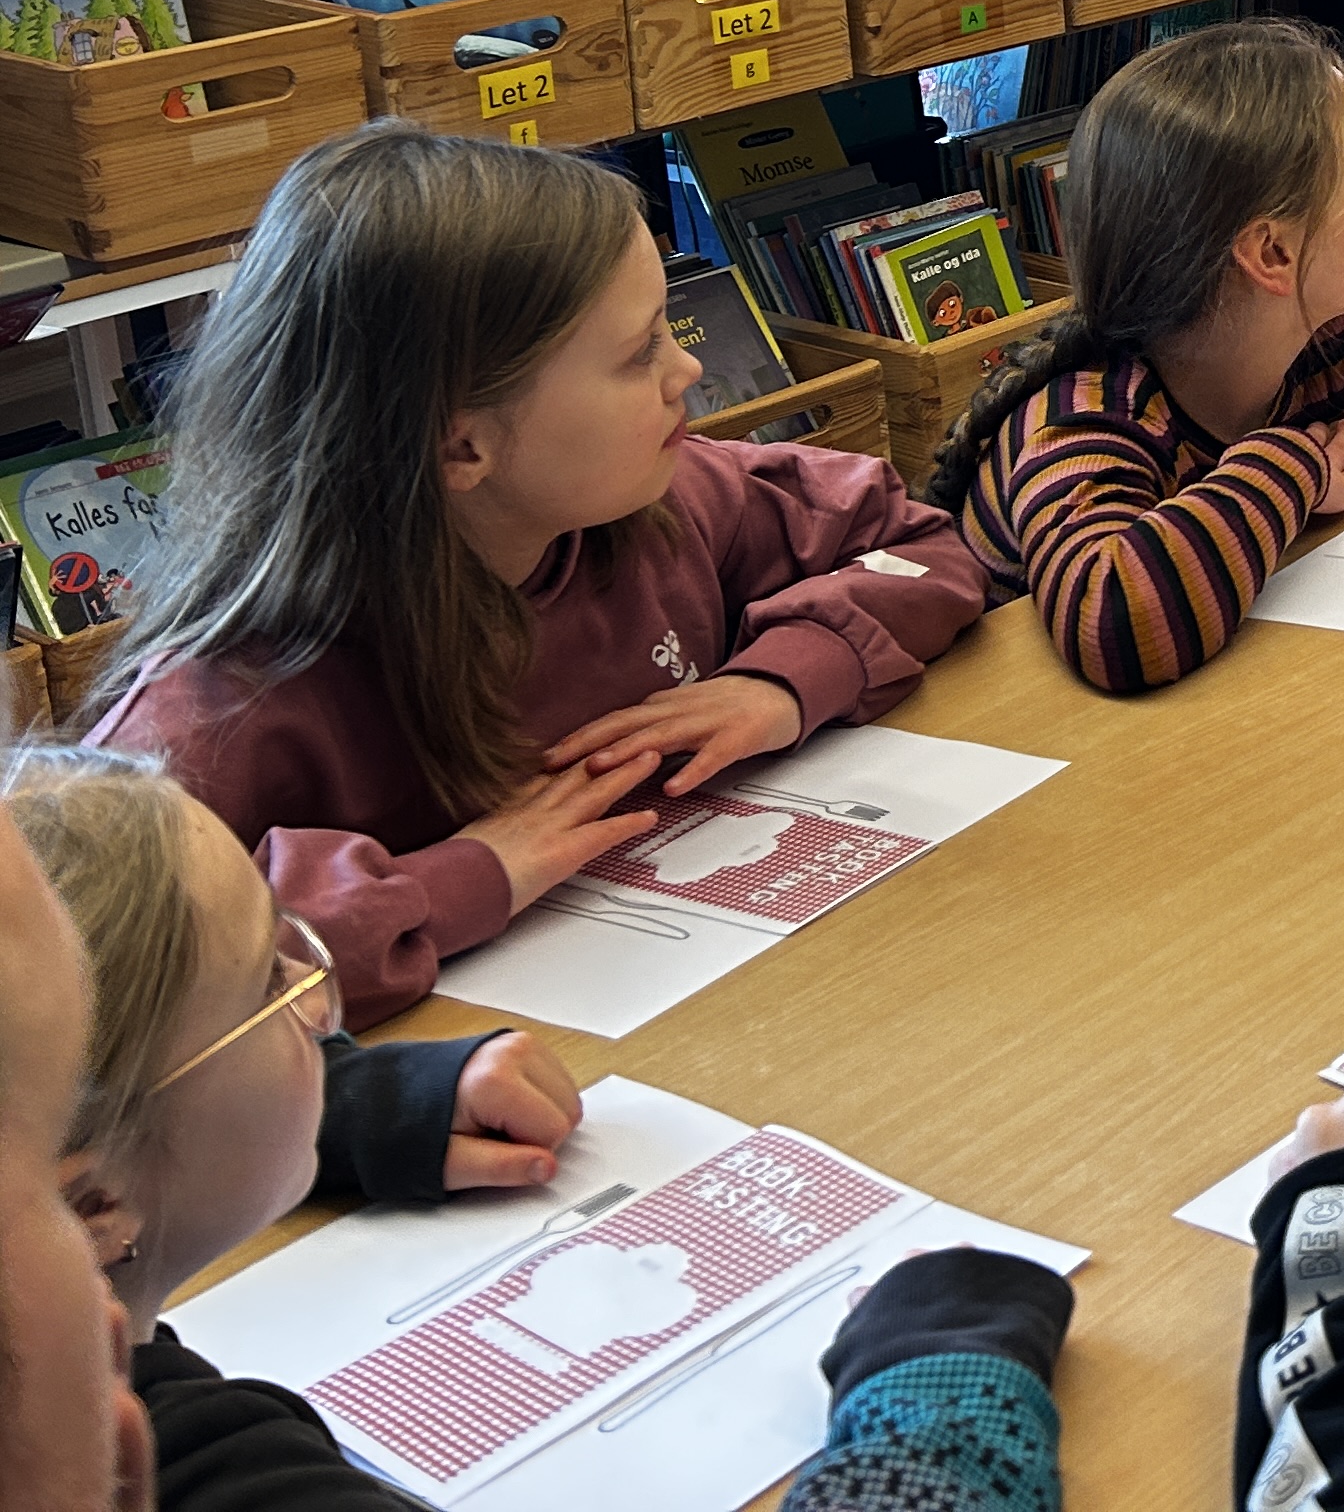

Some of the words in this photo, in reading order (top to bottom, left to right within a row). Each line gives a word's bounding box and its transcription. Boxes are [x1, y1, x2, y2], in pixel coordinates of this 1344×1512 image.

[718, 13, 753, 38] Let
[760, 8, 773, 30] 2
[968, 11, 979, 25] A
[745, 61, 755, 78] g
[487, 82, 527, 109] Let
[535, 74, 549, 98] 2
[520, 128, 528, 144] f
[739, 154, 815, 187] Momse
[911, 264, 942, 284] Kalle
[943, 257, 960, 272] og
[960, 247, 981, 264] Ida
[45, 500, 119, 542] Kalles
[749, 834, 876, 903] TASTING
[816, 838, 902, 884] BOOK
[719, 1150, 817, 1200] BOOK
[682, 1173, 819, 1245] TASTING
[1298, 1230, 1342, 1281] BE
